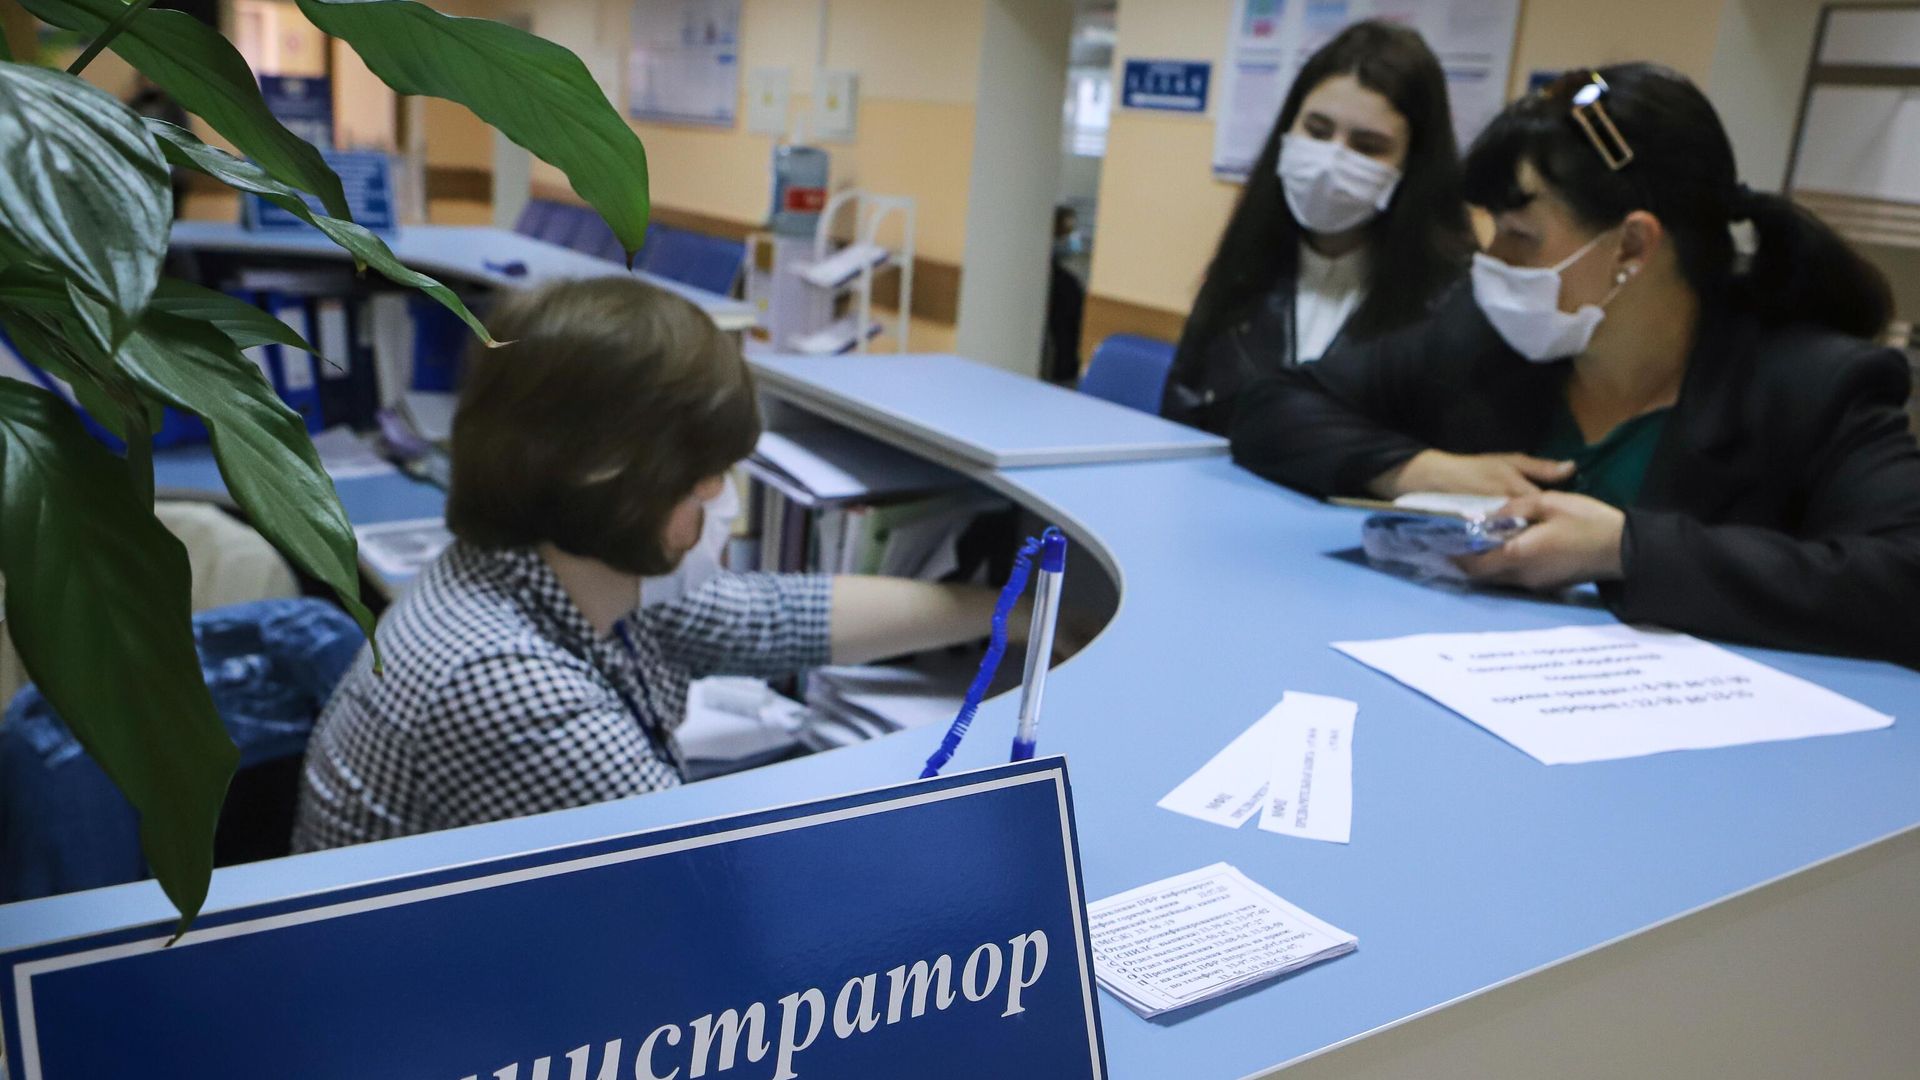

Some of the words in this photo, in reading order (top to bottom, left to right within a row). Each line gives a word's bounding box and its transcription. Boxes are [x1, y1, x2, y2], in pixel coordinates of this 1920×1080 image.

[1092, 904, 1136, 920] правление
[1104, 943, 1133, 953] Отдел
[1123, 955, 1153, 966] Отдел
[1133, 962, 1162, 973] Отдел
[461, 928, 1050, 1080] истратор
